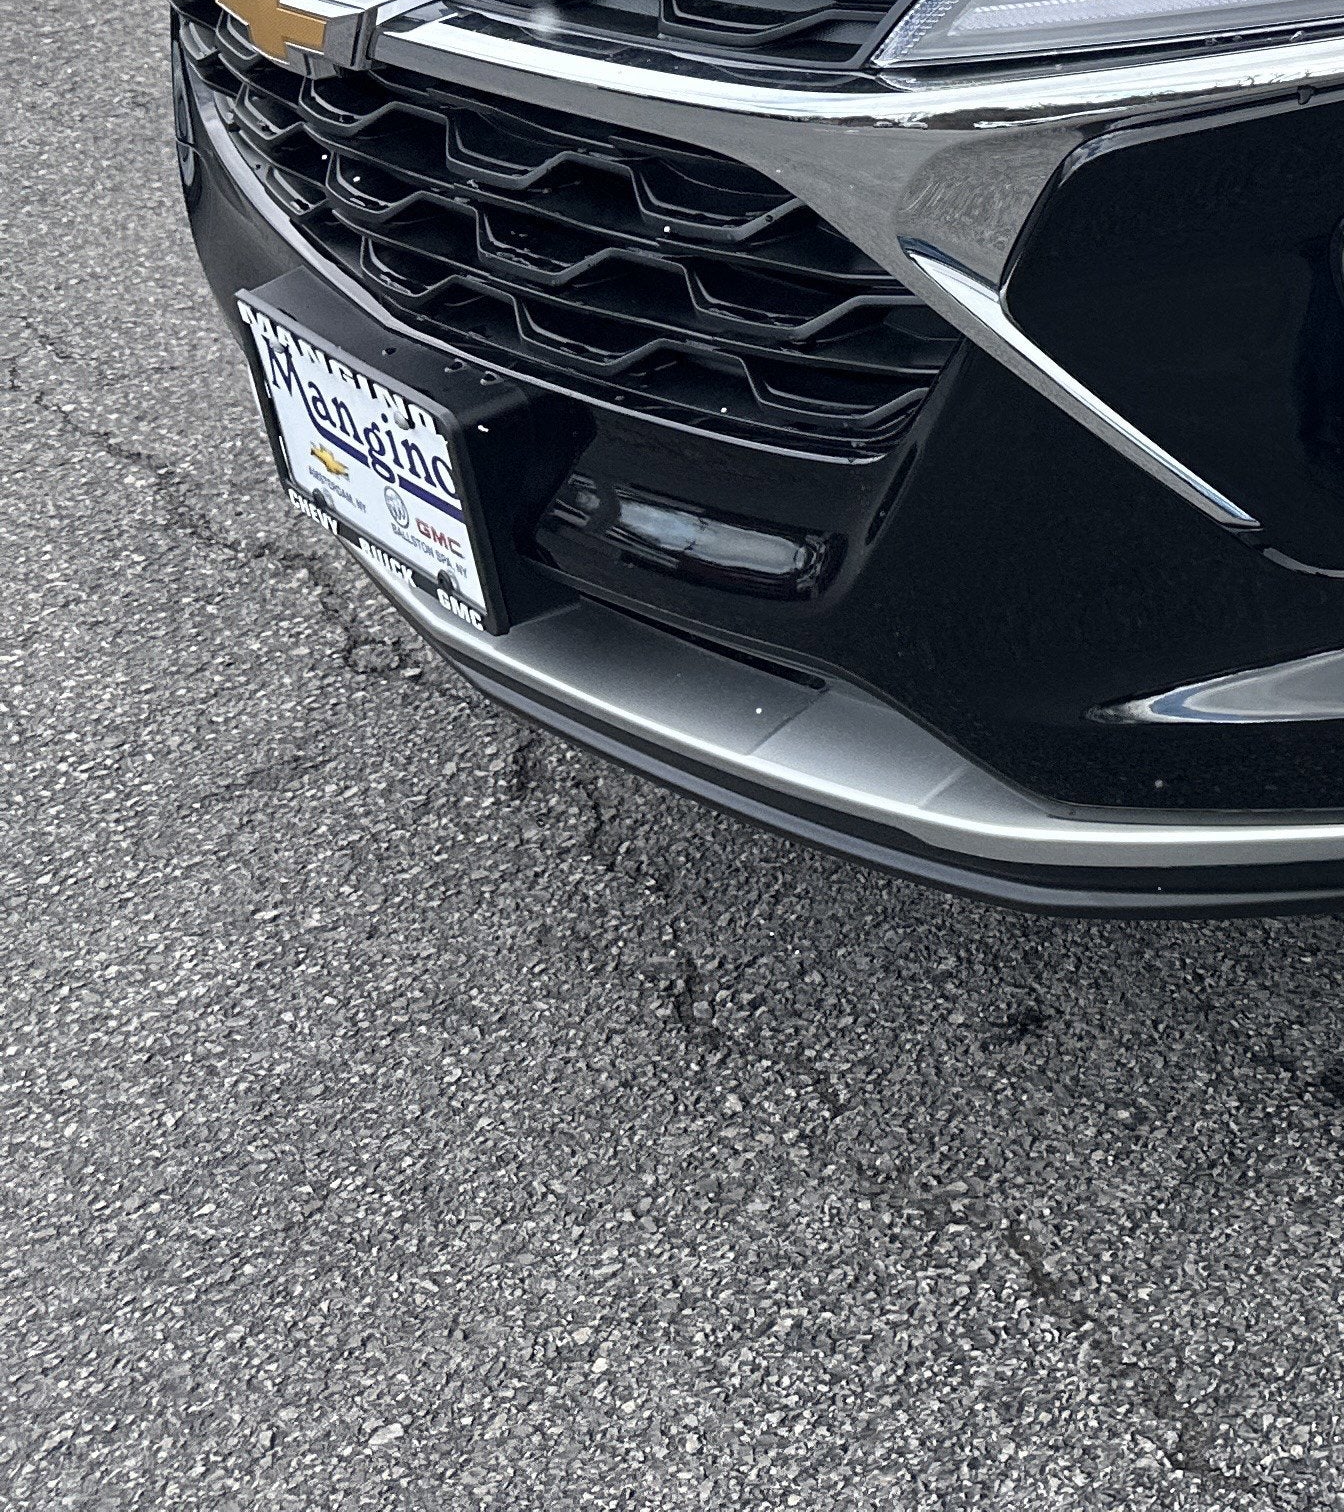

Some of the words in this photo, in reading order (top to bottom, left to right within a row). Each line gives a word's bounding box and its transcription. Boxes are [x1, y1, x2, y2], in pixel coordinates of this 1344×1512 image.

[262, 334, 459, 500] Mangino
[288, 488, 339, 536] CHEVY
[358, 537, 418, 588] BUICK
[436, 588, 484, 631] GMC
[415, 518, 466, 559] GMC
